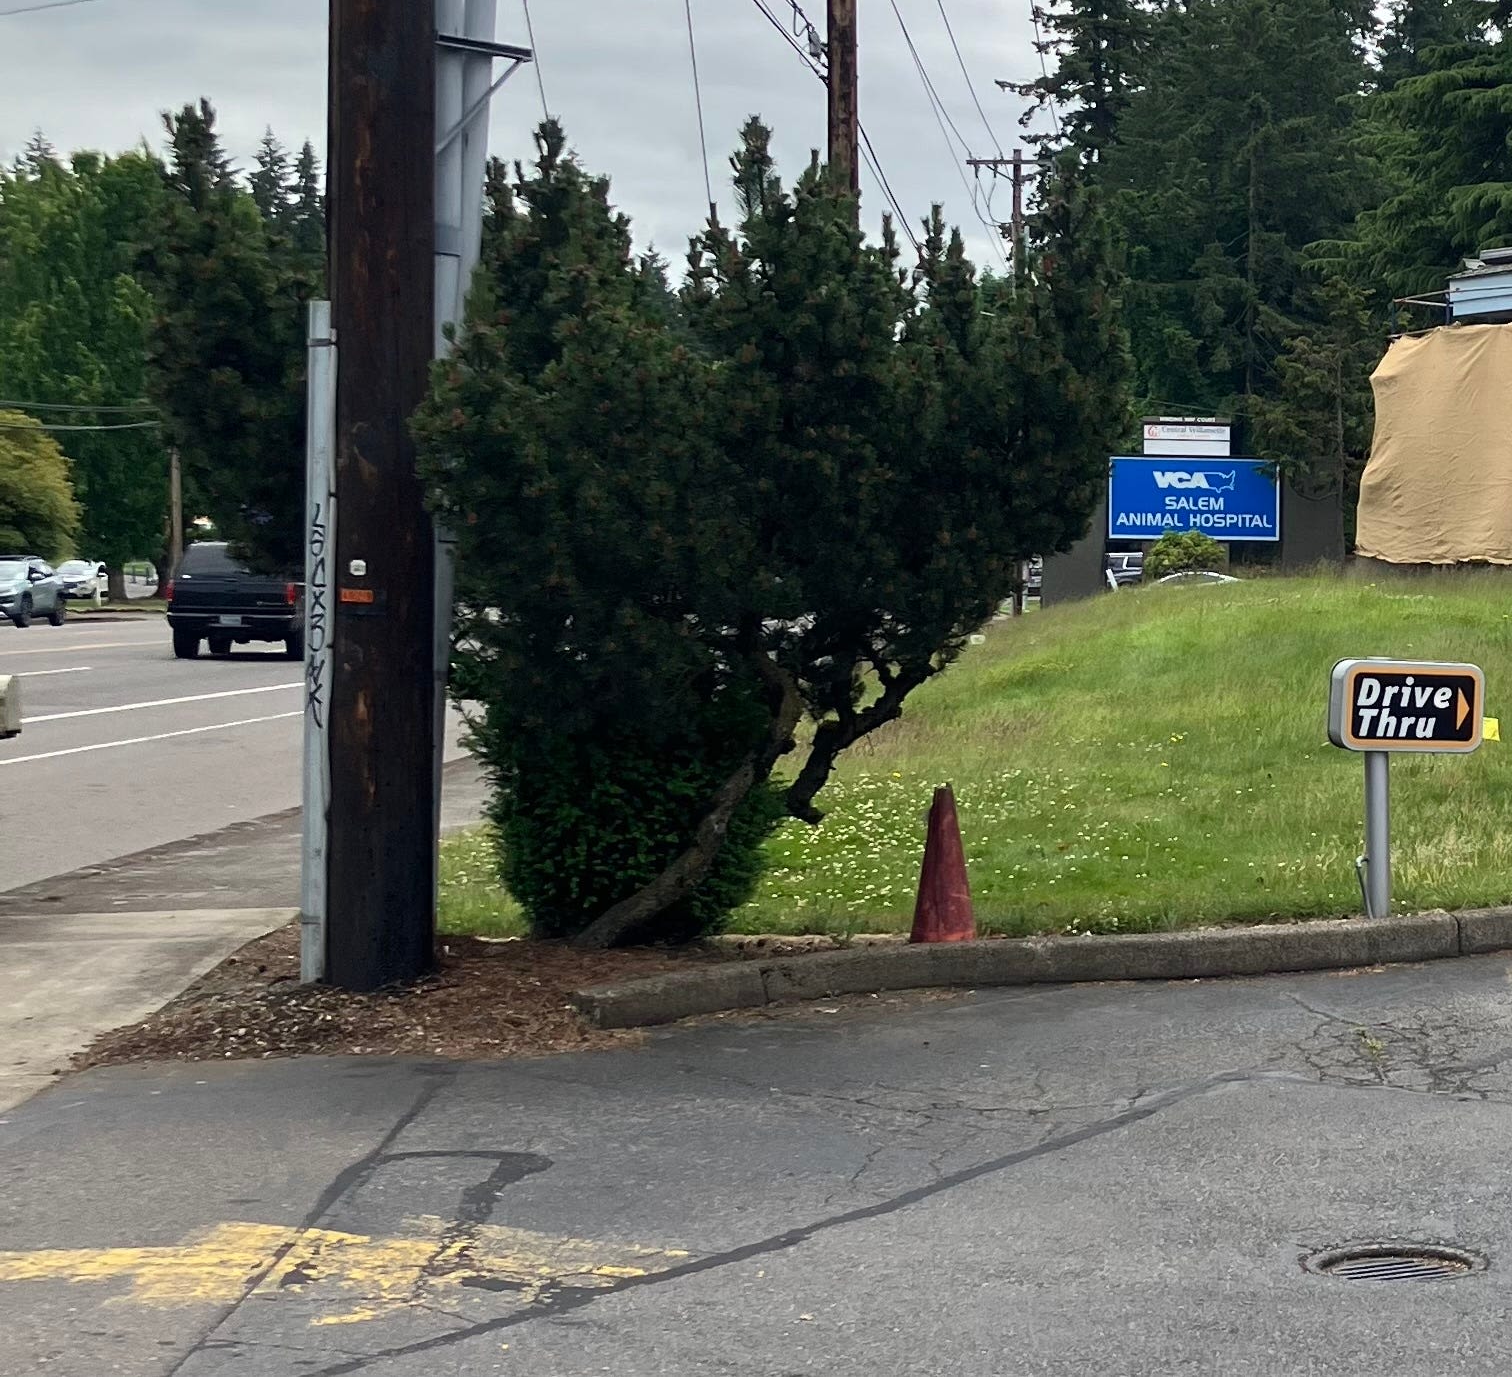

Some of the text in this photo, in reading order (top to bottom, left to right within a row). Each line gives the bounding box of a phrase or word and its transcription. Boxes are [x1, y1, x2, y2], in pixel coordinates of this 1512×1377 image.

[1152, 470, 1210, 489] VCA
[1165, 496, 1225, 511] SALEM
[1116, 512, 1273, 528] ANIMAL HOSPITAL
[1356, 676, 1452, 709] Drive
[1358, 707, 1437, 739] Thru
